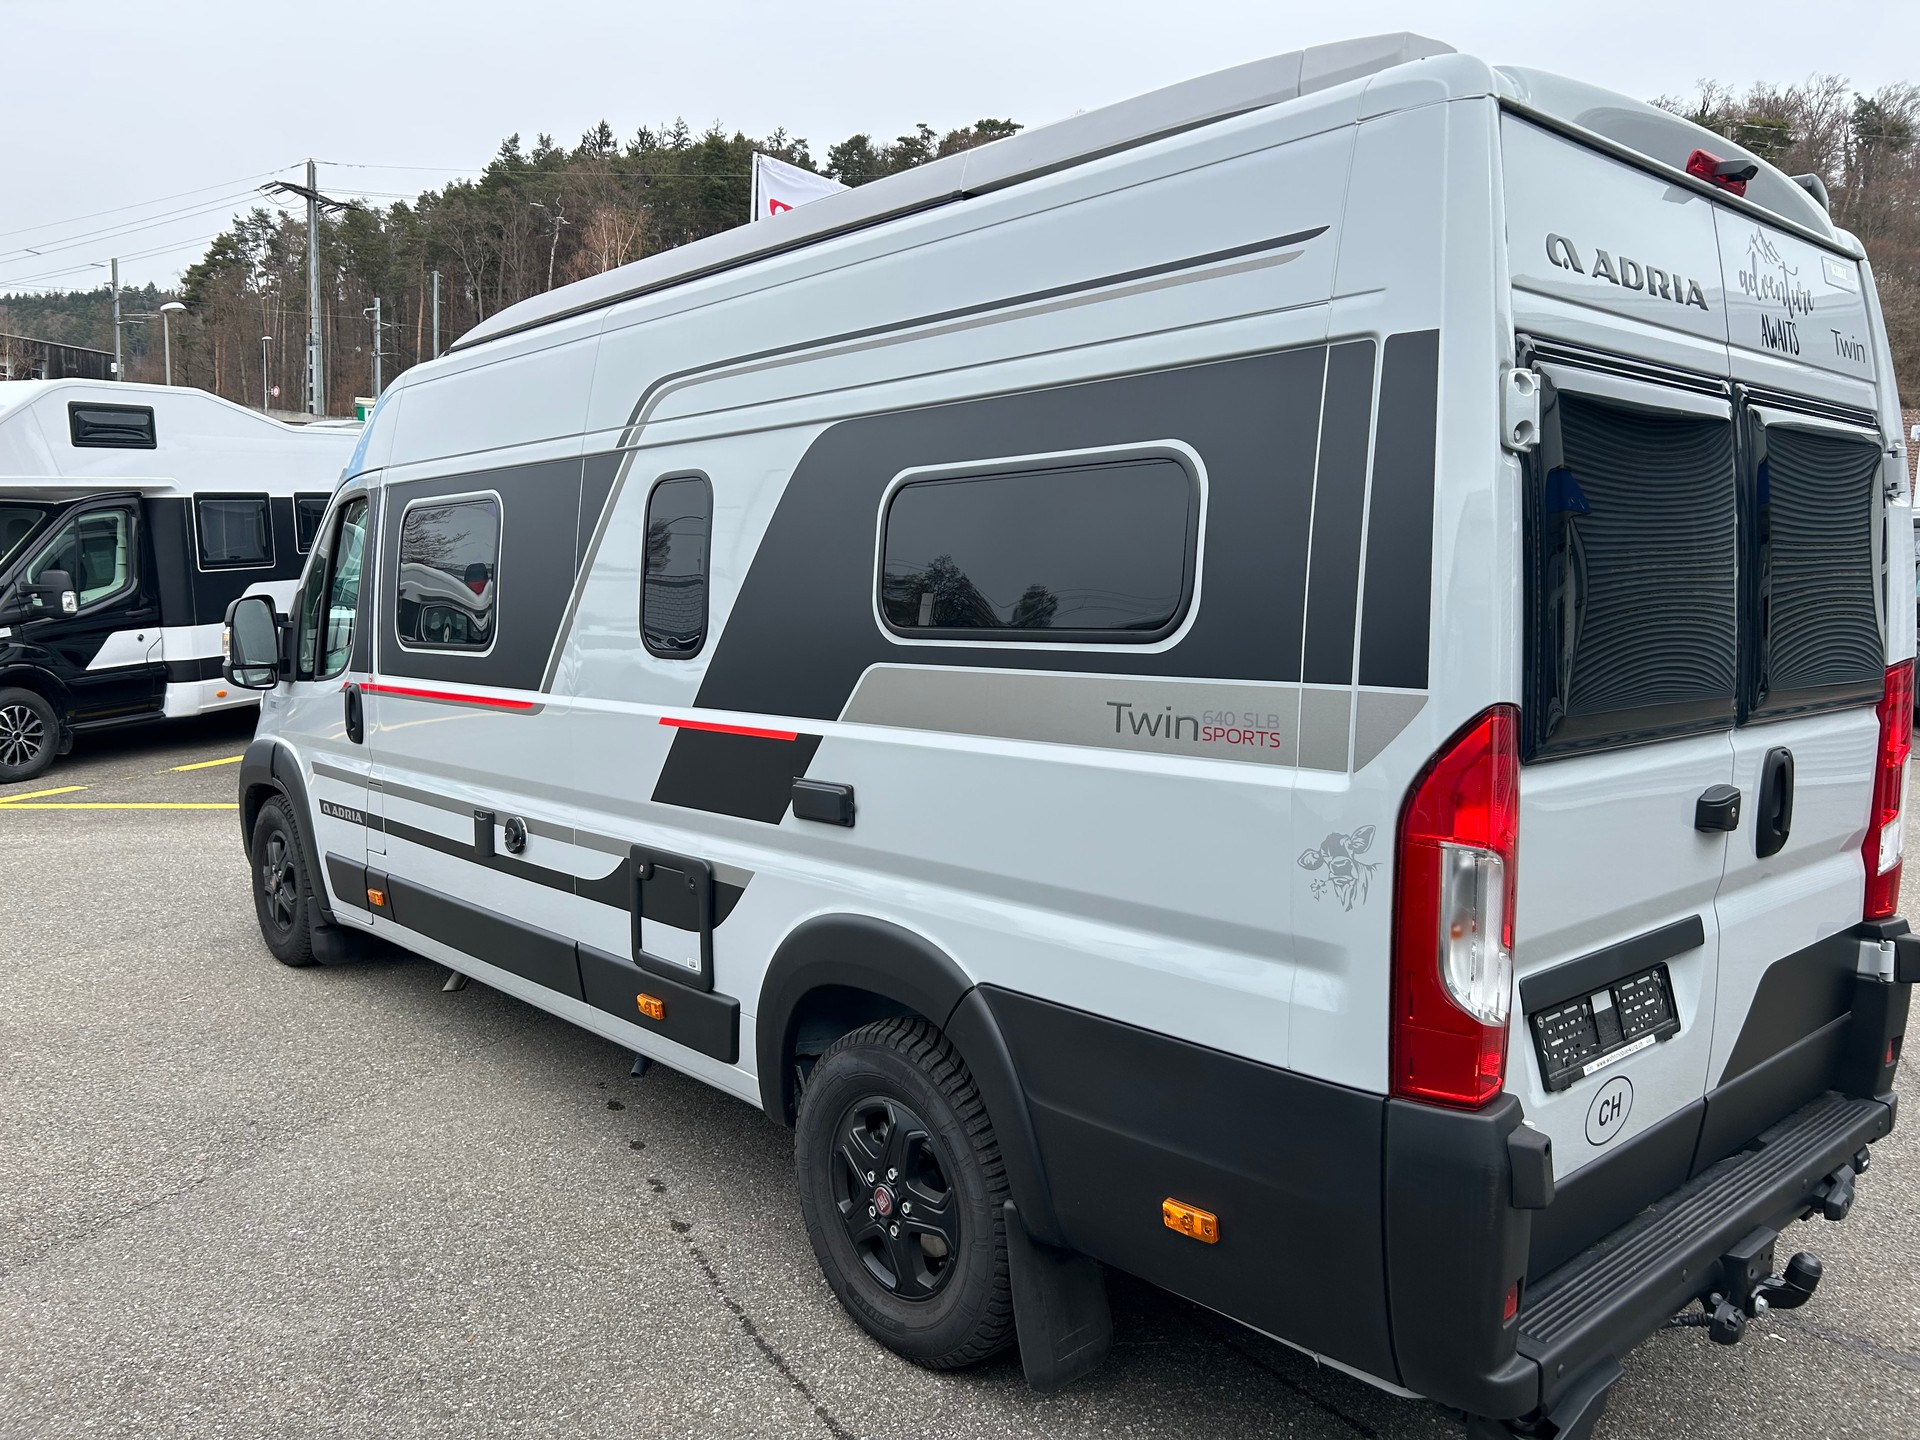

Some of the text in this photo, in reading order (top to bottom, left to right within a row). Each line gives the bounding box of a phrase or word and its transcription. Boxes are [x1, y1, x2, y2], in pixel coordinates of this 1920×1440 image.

[1592, 248, 1709, 311] ADRIA
[1739, 250, 1815, 319] adventure
[1761, 313, 1800, 356] AWAITS
[1830, 328, 1866, 363] Twin
[1106, 701, 1280, 742] Twin 640 SLB
[1202, 726, 1281, 748] SPORTS
[331, 805, 363, 823] ADRIA
[1598, 1091, 1622, 1127] CH
